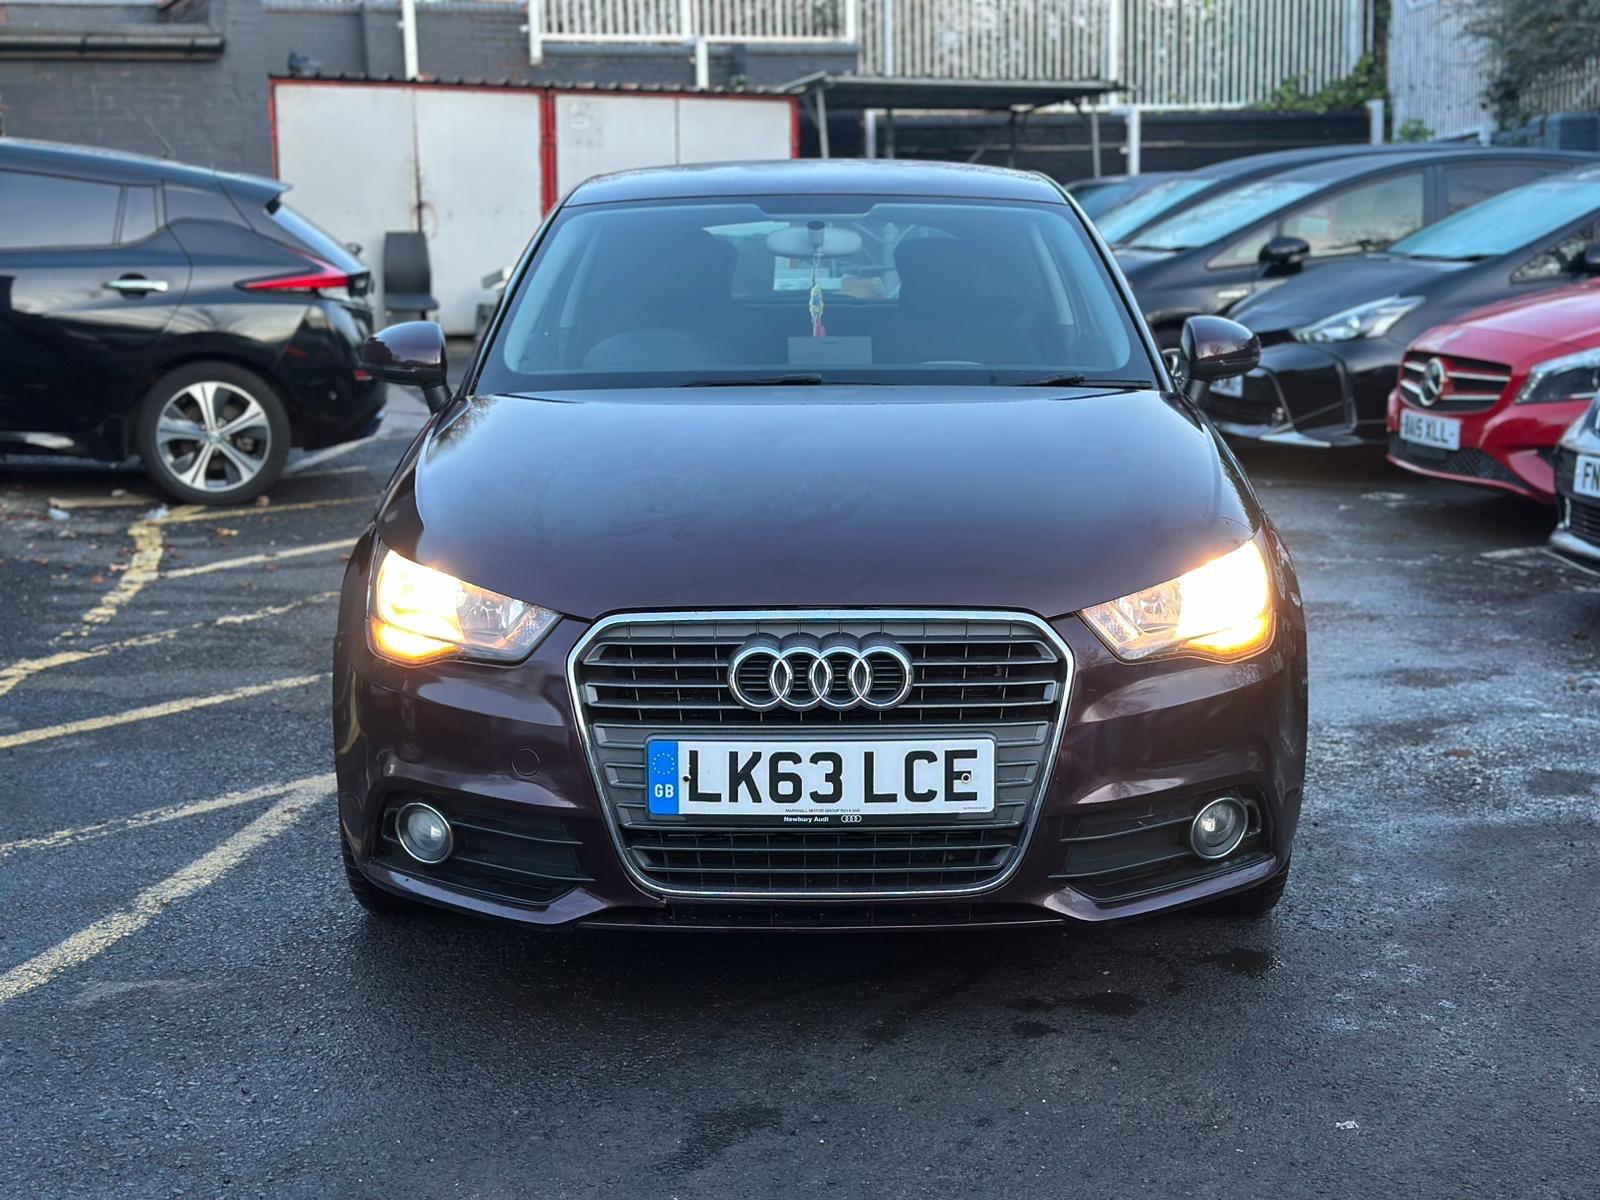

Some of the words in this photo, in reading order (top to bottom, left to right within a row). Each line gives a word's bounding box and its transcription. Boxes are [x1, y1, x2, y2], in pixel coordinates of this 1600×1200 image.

[654, 783, 674, 798] GB
[688, 750, 843, 803] LK63
[864, 749, 978, 803] LCE
